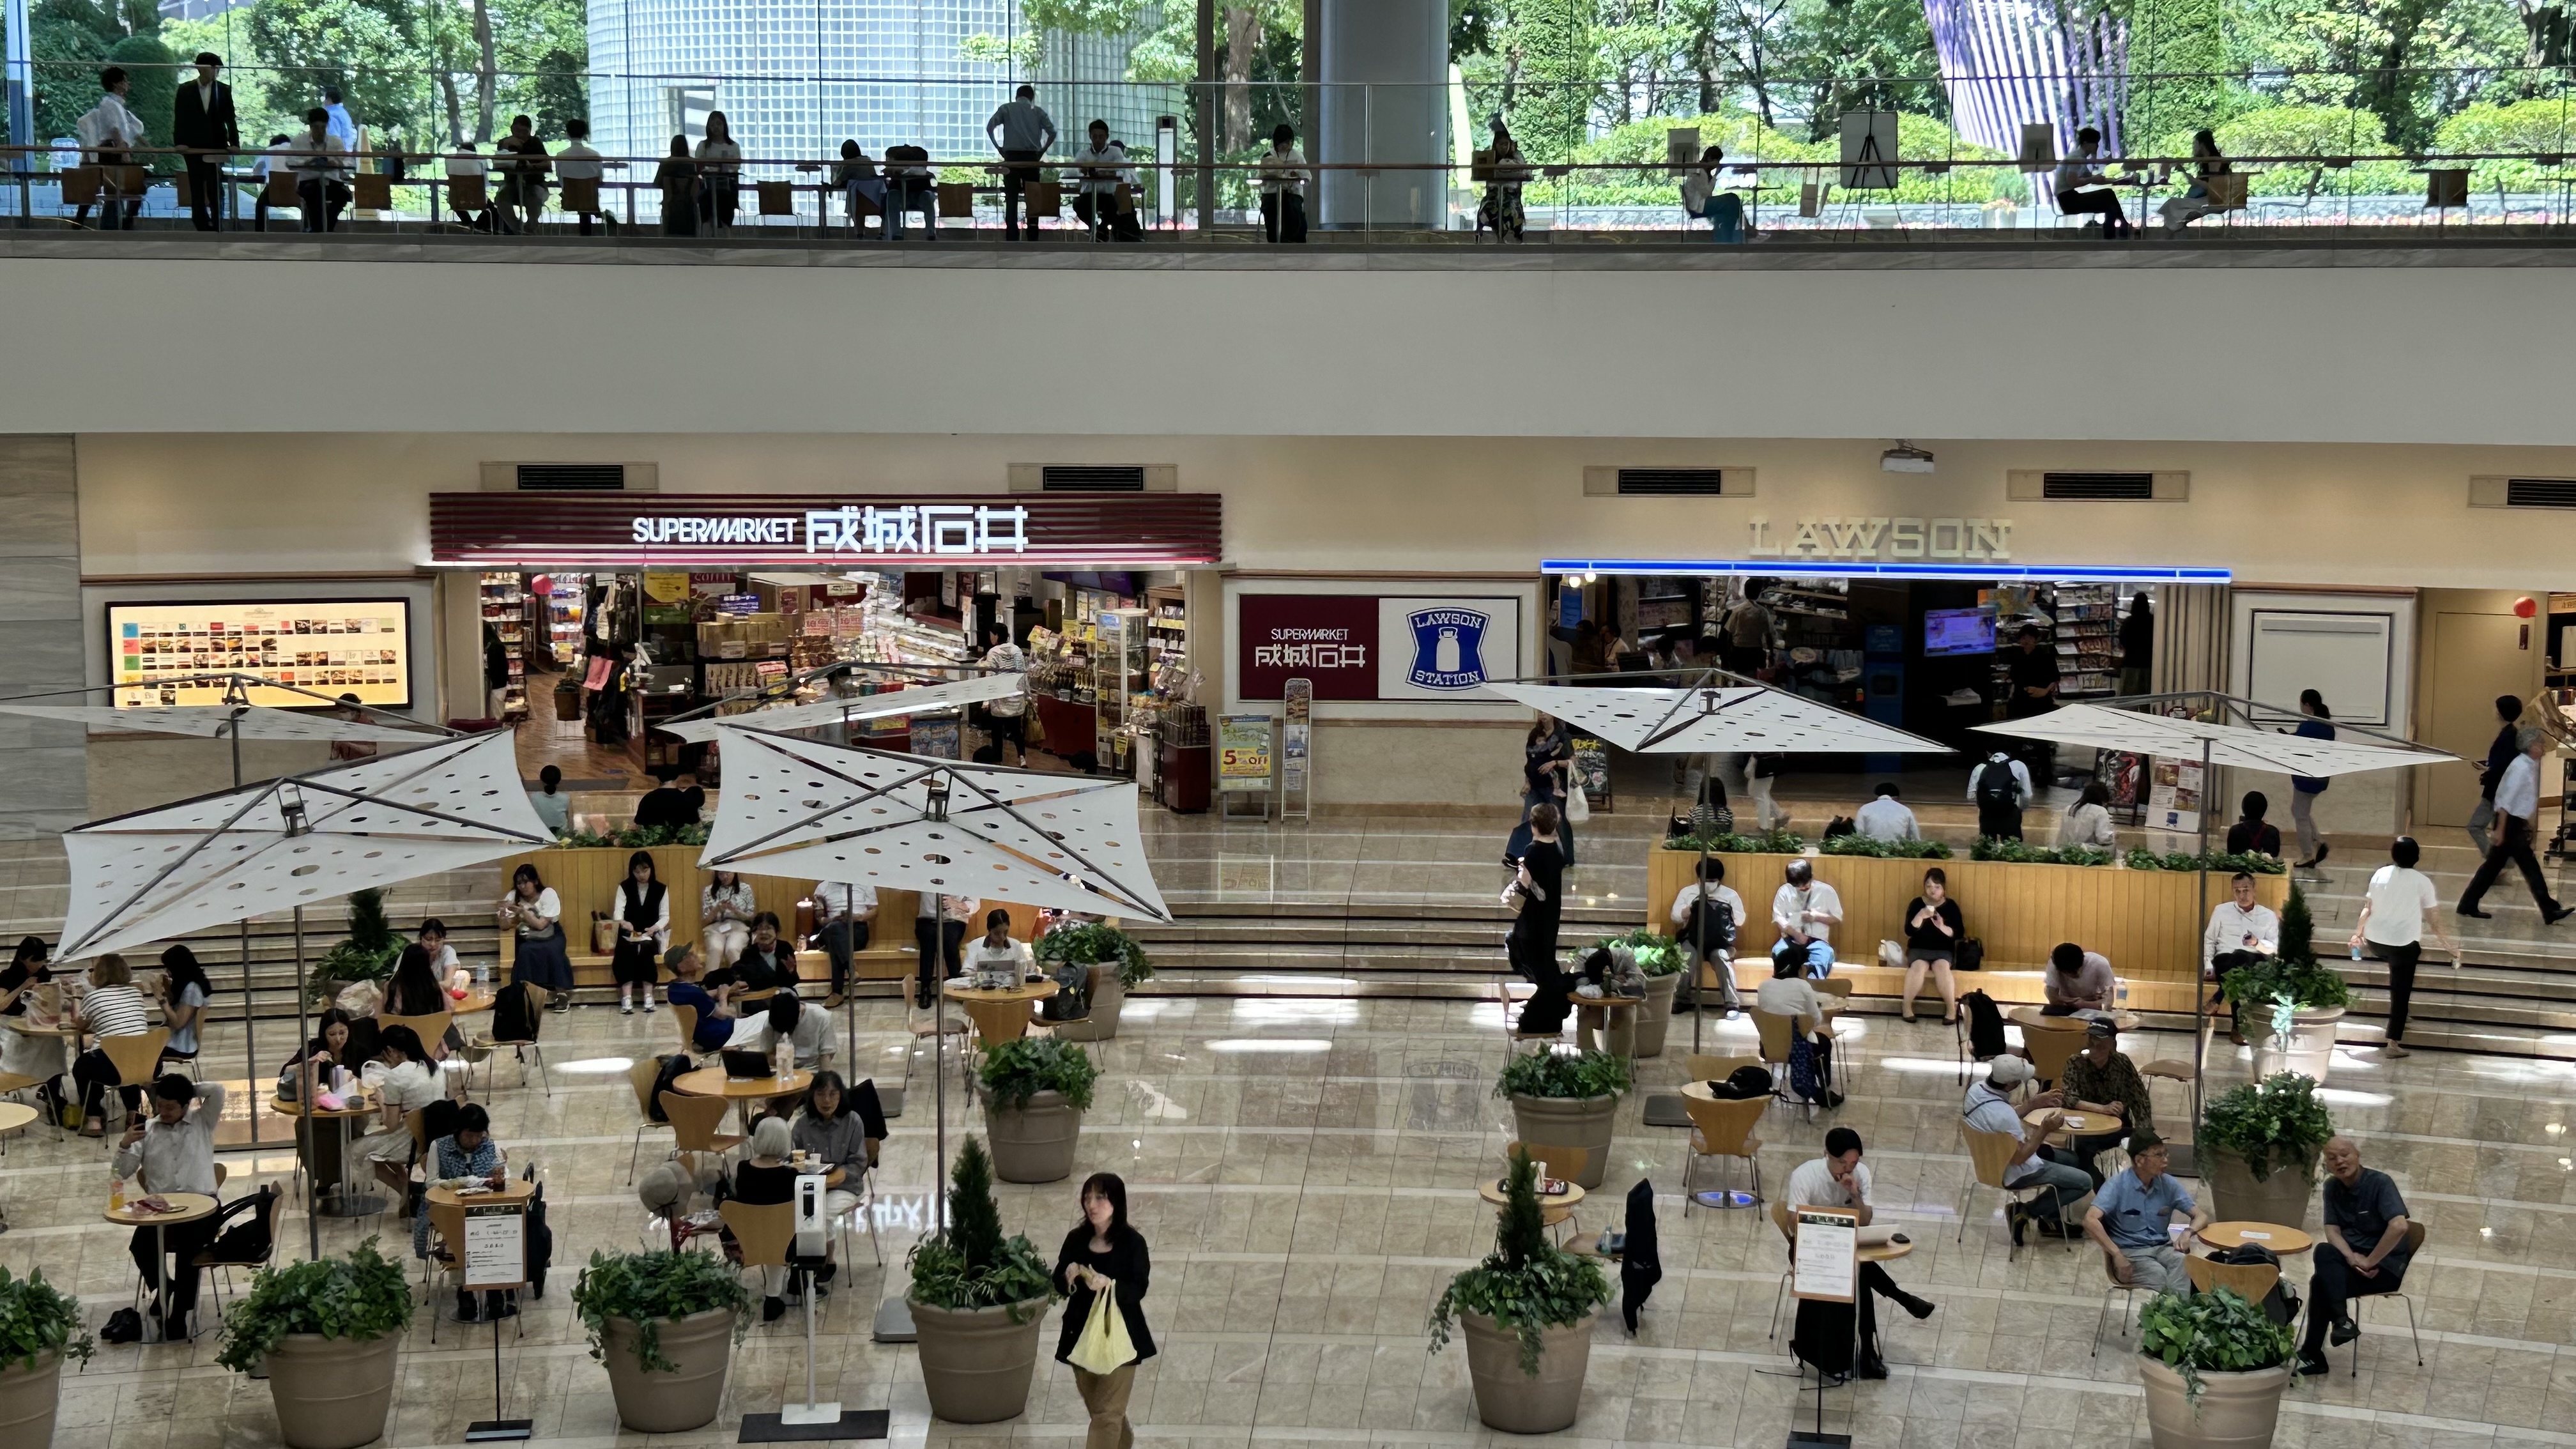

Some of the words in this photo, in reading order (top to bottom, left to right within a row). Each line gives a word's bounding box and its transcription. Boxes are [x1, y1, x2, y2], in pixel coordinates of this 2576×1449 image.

[632, 517, 797, 542] SUPERMARKET
[806, 505, 1029, 553] 成城石井
[1749, 516, 2013, 559] LAWSON
[1414, 613, 1482, 629] LAWSON
[1271, 628, 1349, 641] SUPERMARKET
[1255, 643, 1366, 668] 成城石井
[1414, 670, 1481, 686] STATION
